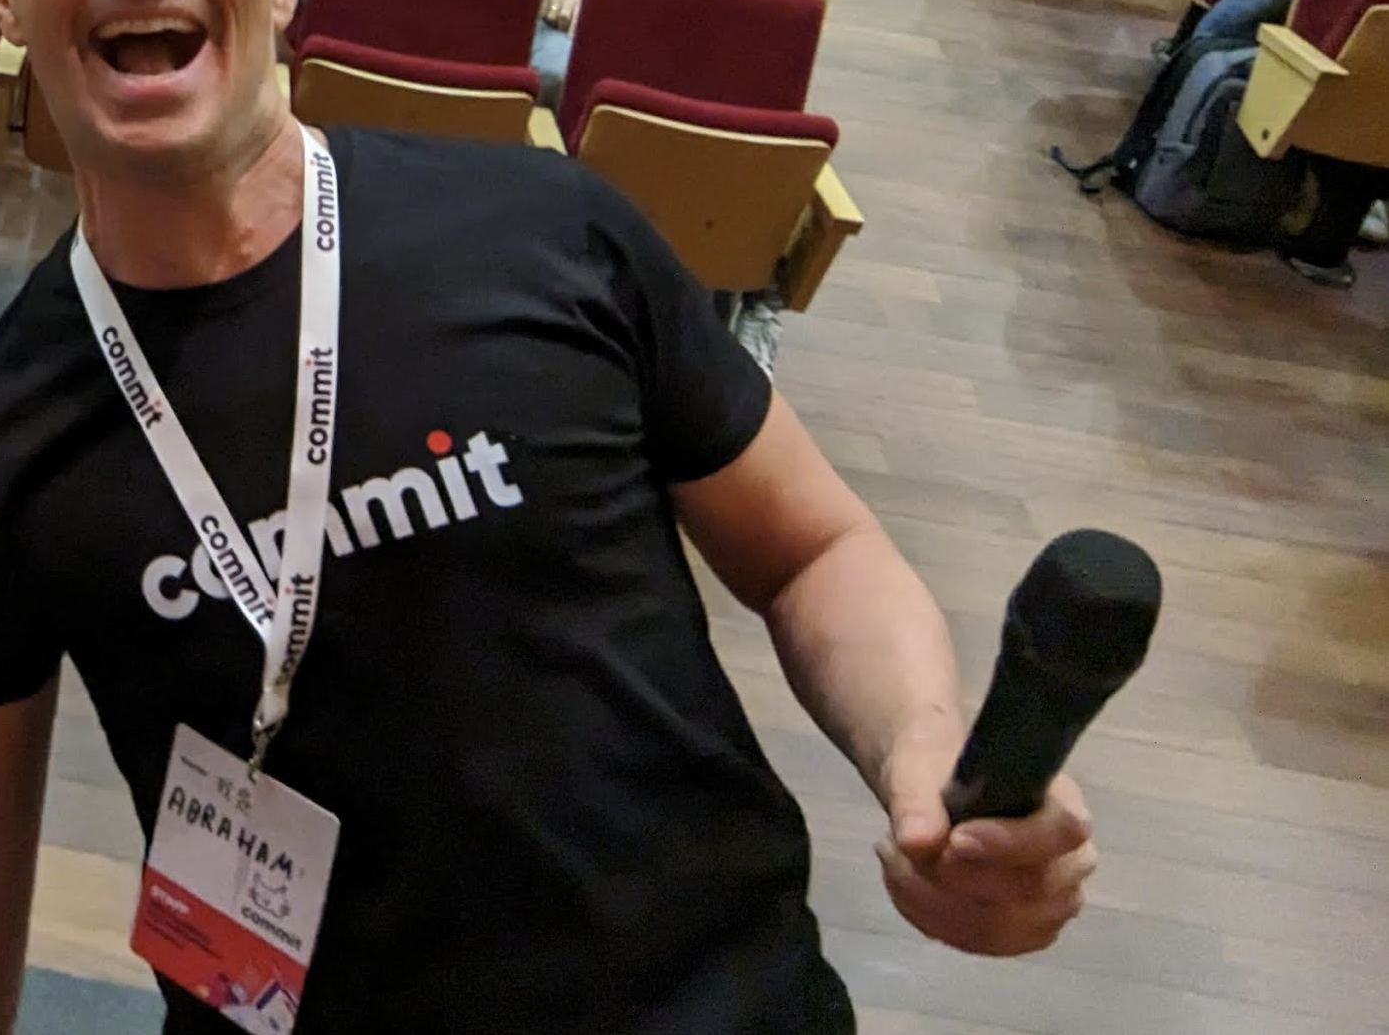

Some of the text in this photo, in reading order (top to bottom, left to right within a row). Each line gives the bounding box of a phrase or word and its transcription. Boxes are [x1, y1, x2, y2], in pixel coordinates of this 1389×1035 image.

[310, 152, 337, 252] commit
[101, 325, 165, 430] commit
[305, 346, 334, 465] commit
[200, 514, 276, 626] commit
[166, 785, 295, 882] ABRAHAM
[240, 905, 303, 952] commit
